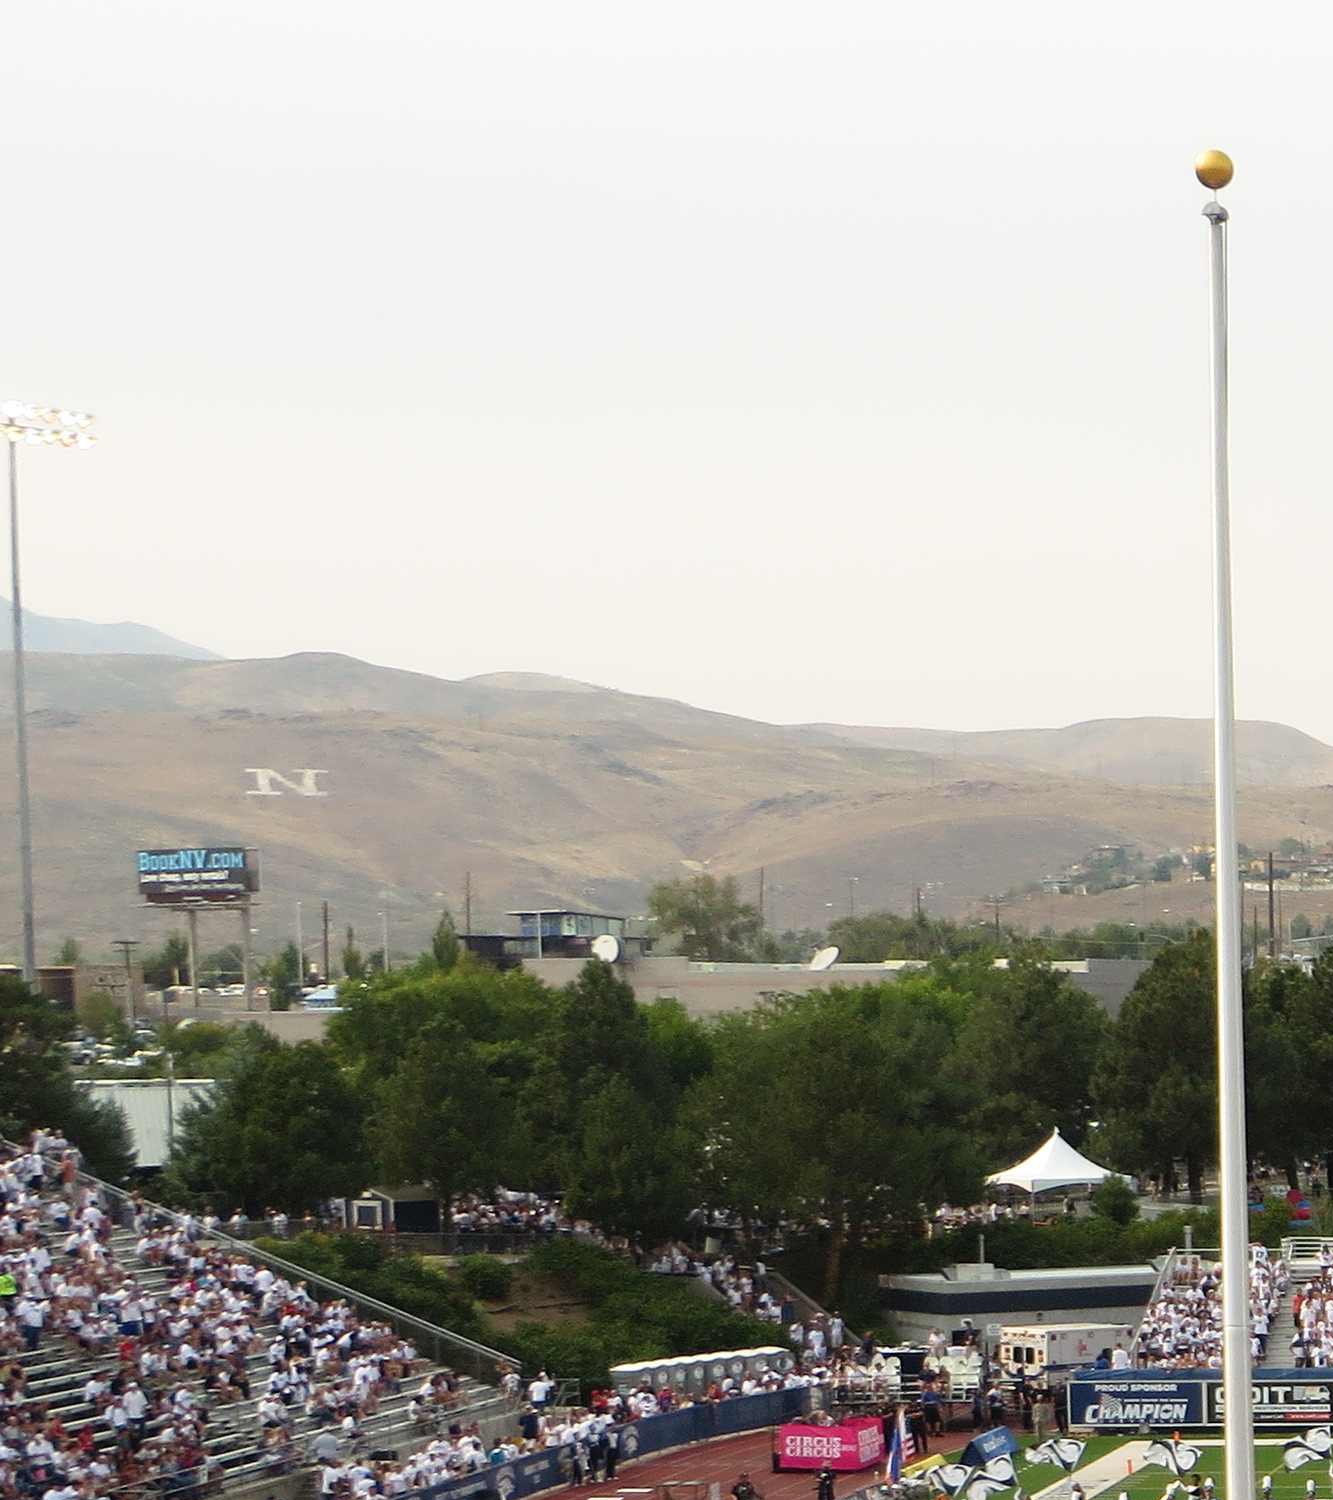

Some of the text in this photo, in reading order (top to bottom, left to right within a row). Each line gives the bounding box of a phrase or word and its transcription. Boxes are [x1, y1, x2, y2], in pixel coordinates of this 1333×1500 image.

[245, 768, 329, 796] N
[1095, 1384, 1178, 1392] PROUD SPONSOR
[1084, 1403, 1188, 1423] CHAMPION
[786, 1435, 842, 1447] CIRCUS
[786, 1445, 842, 1459] CIRCUS
